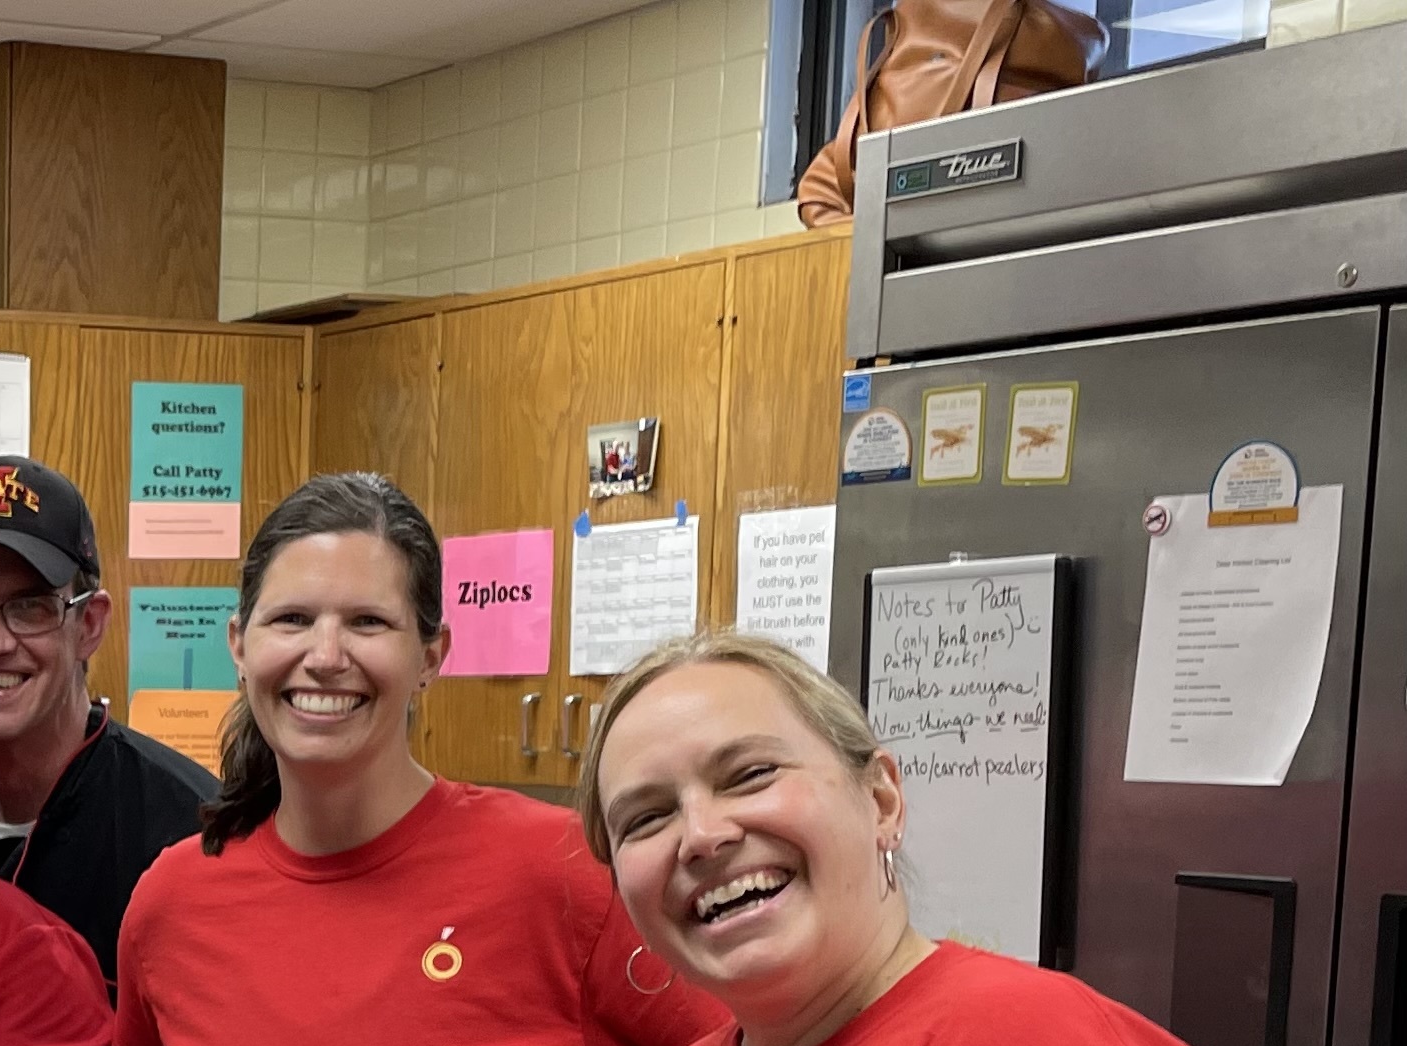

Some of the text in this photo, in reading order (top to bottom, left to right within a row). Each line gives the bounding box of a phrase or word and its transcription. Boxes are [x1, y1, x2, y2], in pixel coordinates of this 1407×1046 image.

[939, 152, 1007, 179] True
[161, 401, 217, 415] Kitchen
[151, 421, 225, 435] questions?
[153, 465, 224, 481] Call Patty
[753, 530, 825, 551] If you have pet
[759, 554, 818, 569] hair on your
[757, 574, 818, 590] clothing, you
[457, 580, 532, 610] Ziplocs
[753, 594, 822, 610] MUST use the
[878, 577, 1025, 630] Notes to Patty
[156, 618, 217, 627] Sign In
[764, 616, 791, 629] brush
[794, 613, 825, 628] before
[166, 631, 206, 640] Here
[796, 635, 815, 648] with
[895, 613, 1015, 656] (only kind ones)
[883, 651, 921, 675] Patty
[872, 671, 1040, 707] Thanks everyone!
[158, 707, 210, 720] Volunteers
[916, 709, 980, 744] things
[898, 752, 980, 784] tato/carrot
